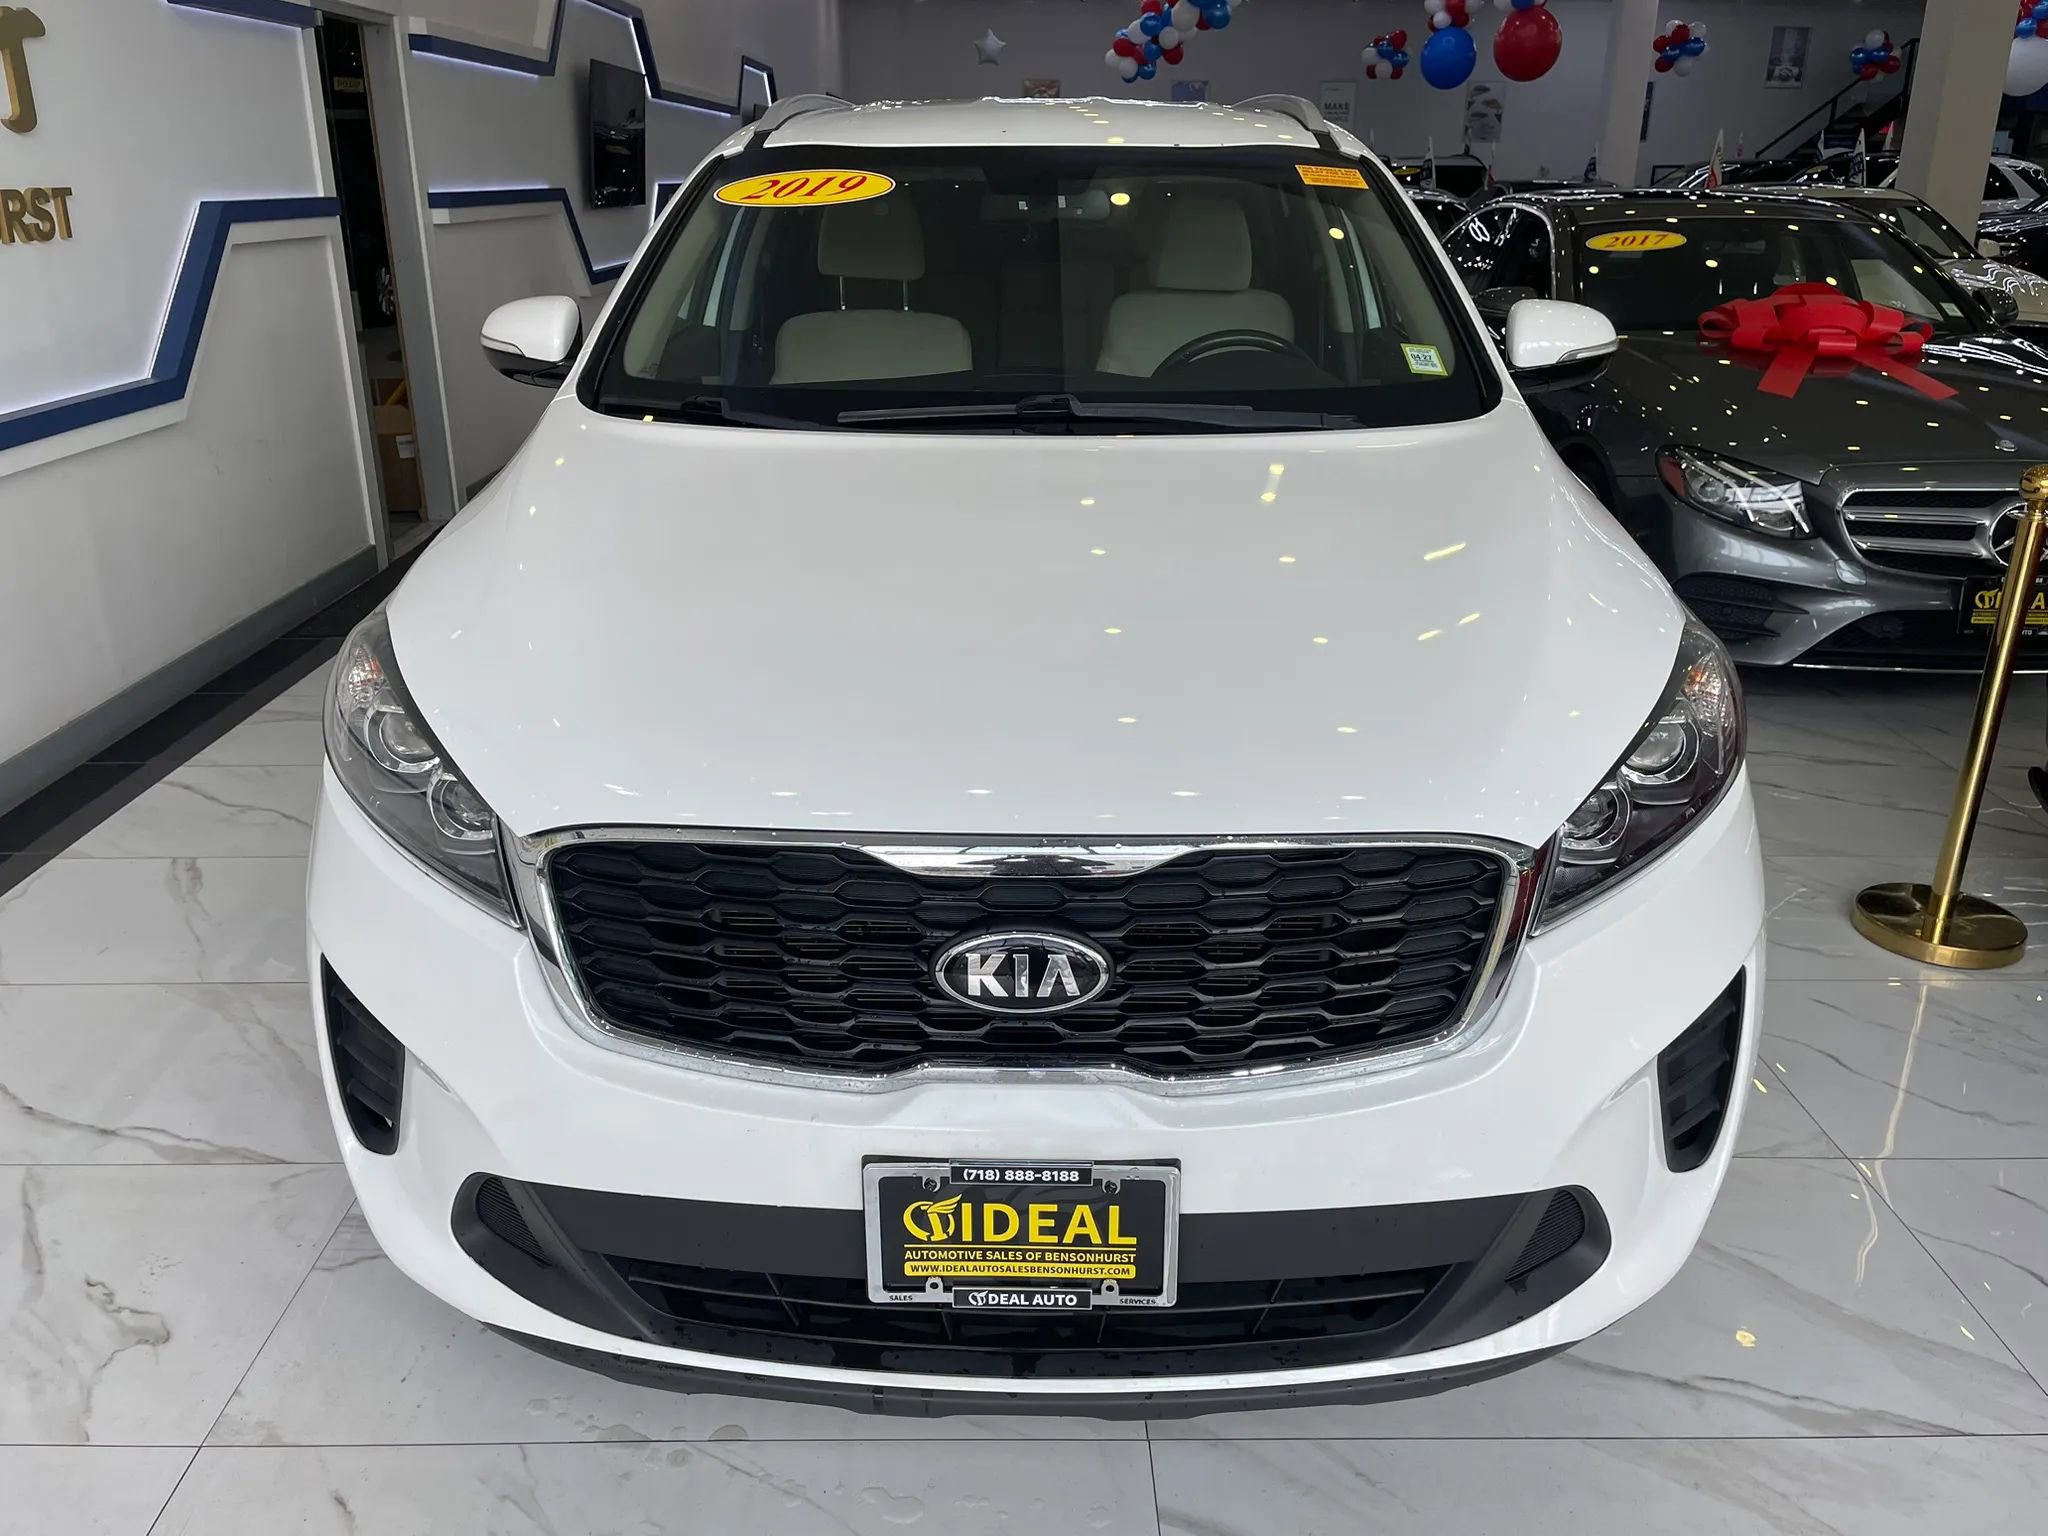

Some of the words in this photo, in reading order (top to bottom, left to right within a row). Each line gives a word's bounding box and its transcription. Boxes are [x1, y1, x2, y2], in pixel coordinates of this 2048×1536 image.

[739, 175, 868, 200] 2019
[1604, 233, 1668, 248] 2017
[965, 953, 1080, 997] KIA
[963, 1168, 1000, 1181] (718)
[1004, 1169, 1079, 1182] 888-8188
[961, 1202, 1137, 1245] IDEAL
[904, 1250, 983, 1260] AUTOMOTIVE
[986, 1251, 1023, 1261] SALES
[1025, 1252, 1042, 1261] OF
[1045, 1252, 1137, 1263] BENSONHURST
[910, 1264, 1131, 1276] WWW.IDEALAUTOSALESBENSONHURST.COM
[1032, 1294, 1078, 1306] AUTO
[1120, 1297, 1157, 1305] SERVICES
